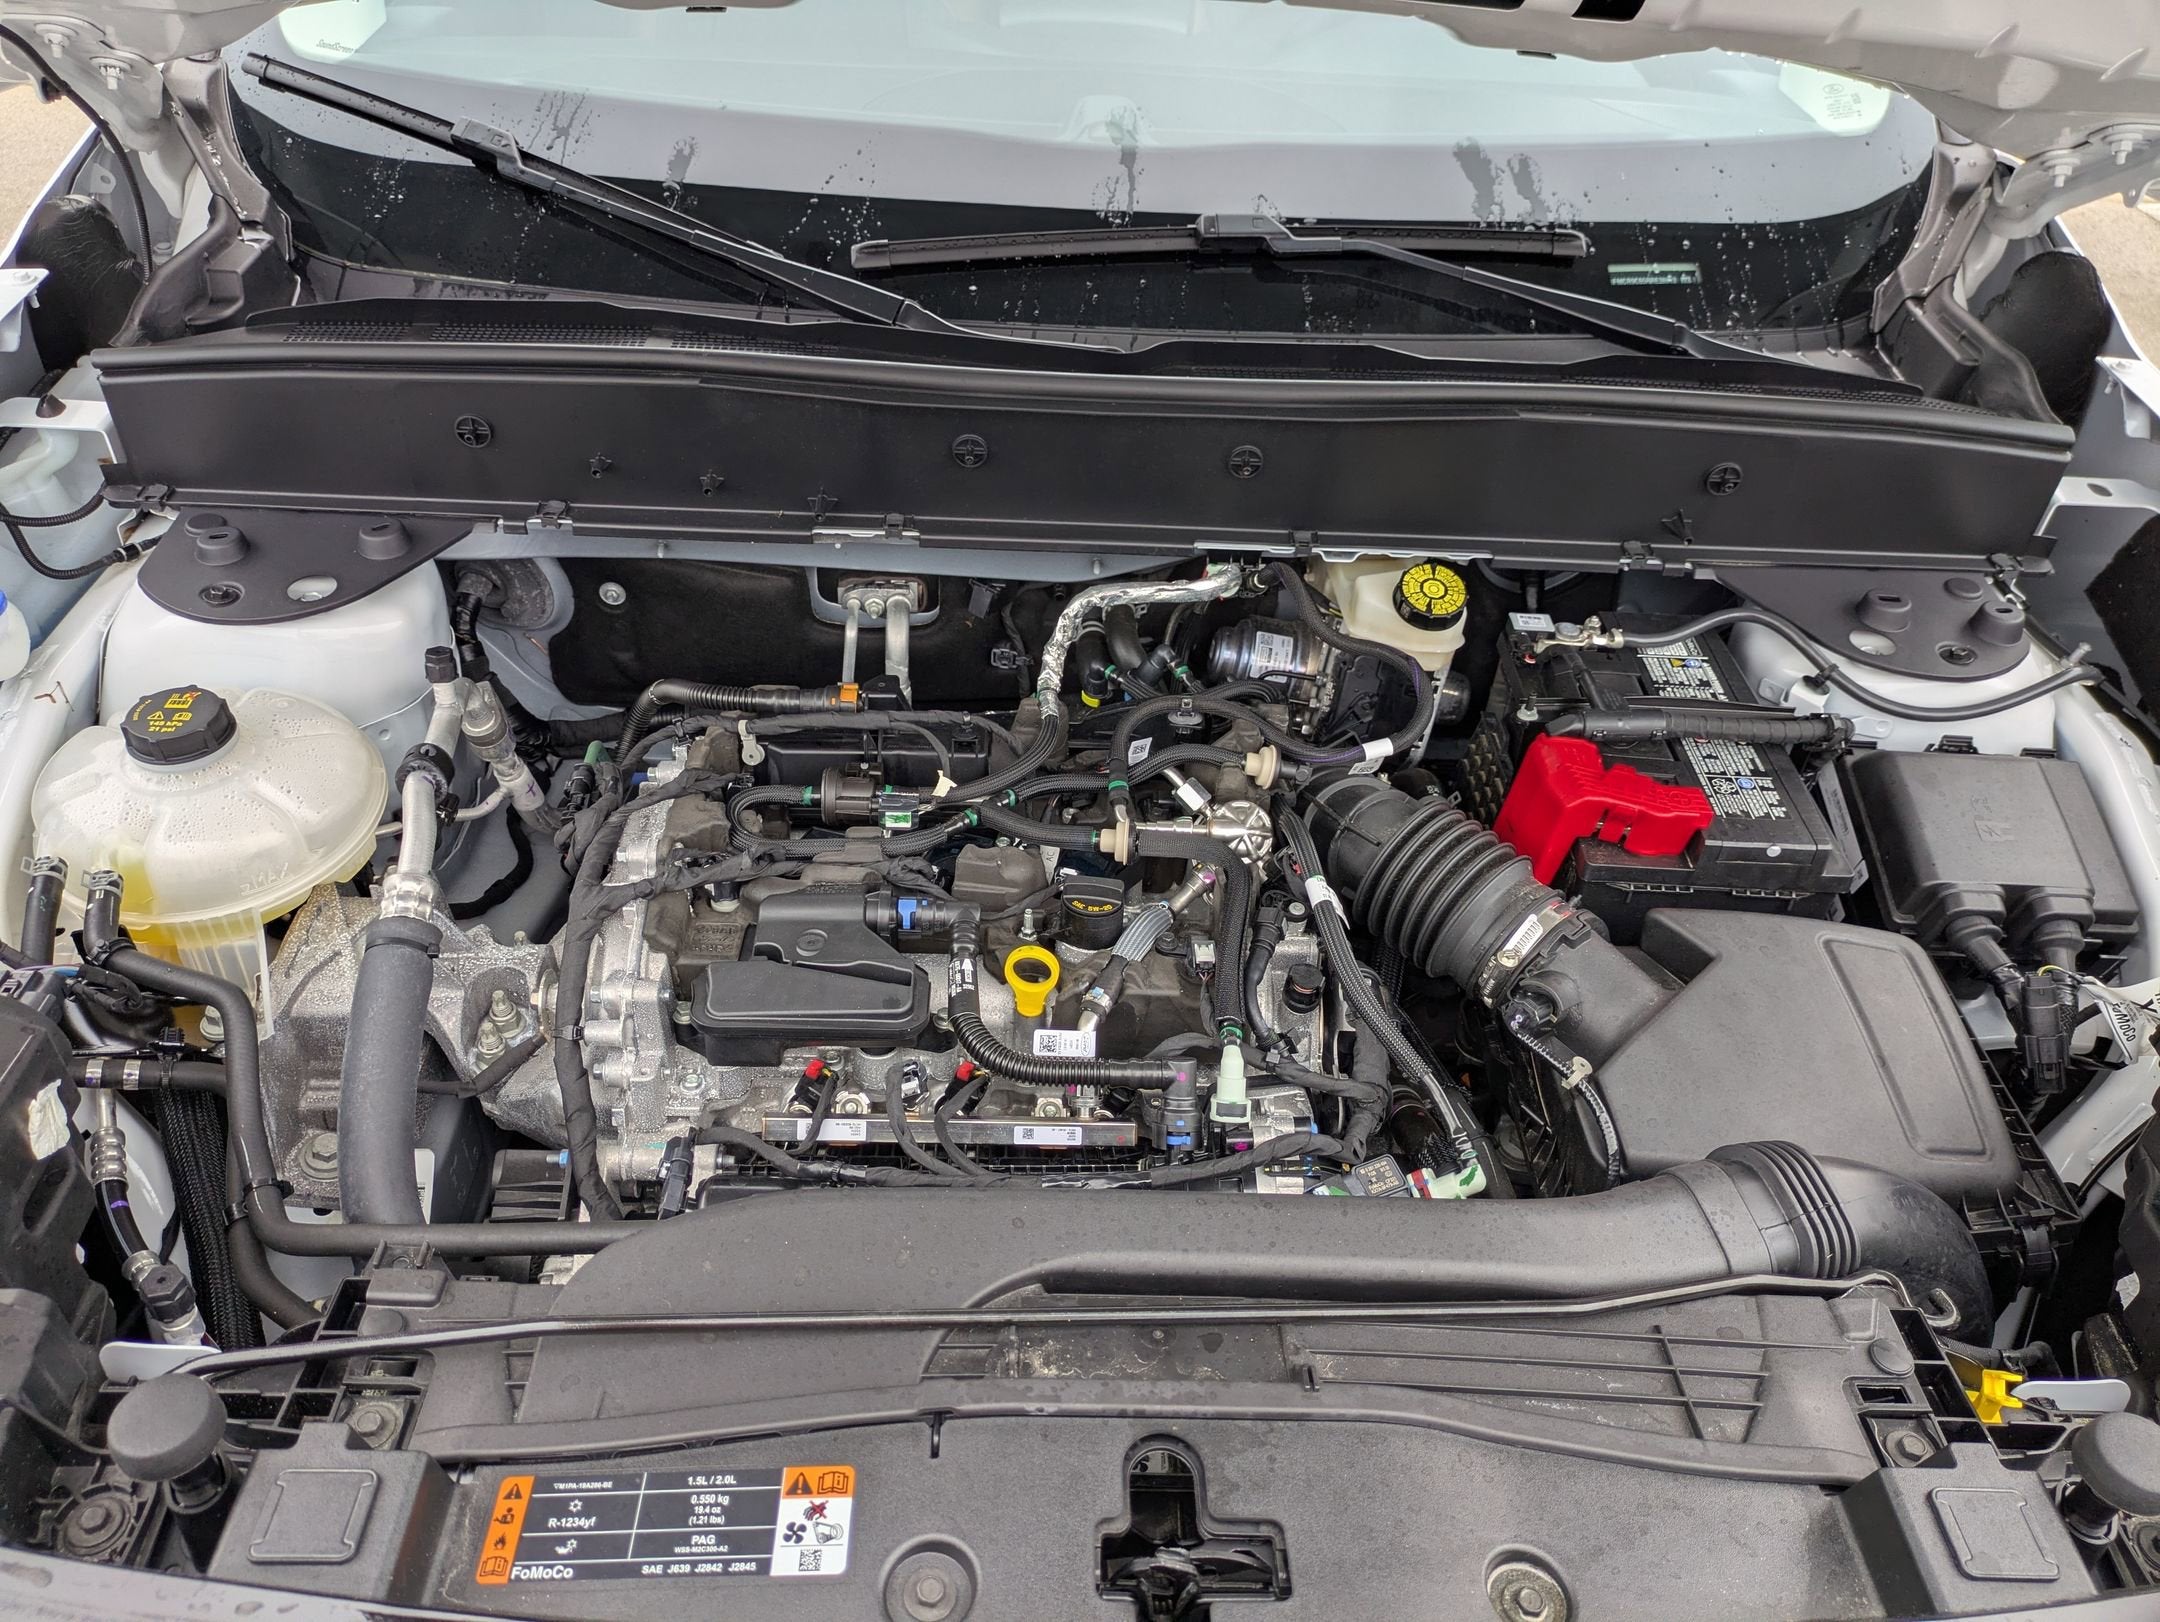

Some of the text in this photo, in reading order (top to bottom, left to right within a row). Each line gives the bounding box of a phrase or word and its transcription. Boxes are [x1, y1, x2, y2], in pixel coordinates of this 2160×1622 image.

[687, 1476, 708, 1485] 1.5L
[715, 1475, 737, 1484] 2.0L
[690, 1494, 730, 1505] 0.550 kg
[694, 1506, 710, 1514] 19.4
[548, 1516, 596, 1529] R-1234yf
[688, 1515, 725, 1525] (1.21 lbs)
[690, 1535, 716, 1545] PAG
[511, 1565, 574, 1580] FoMoCo
[641, 1562, 757, 1574] SAE J639 J2842 J2845
